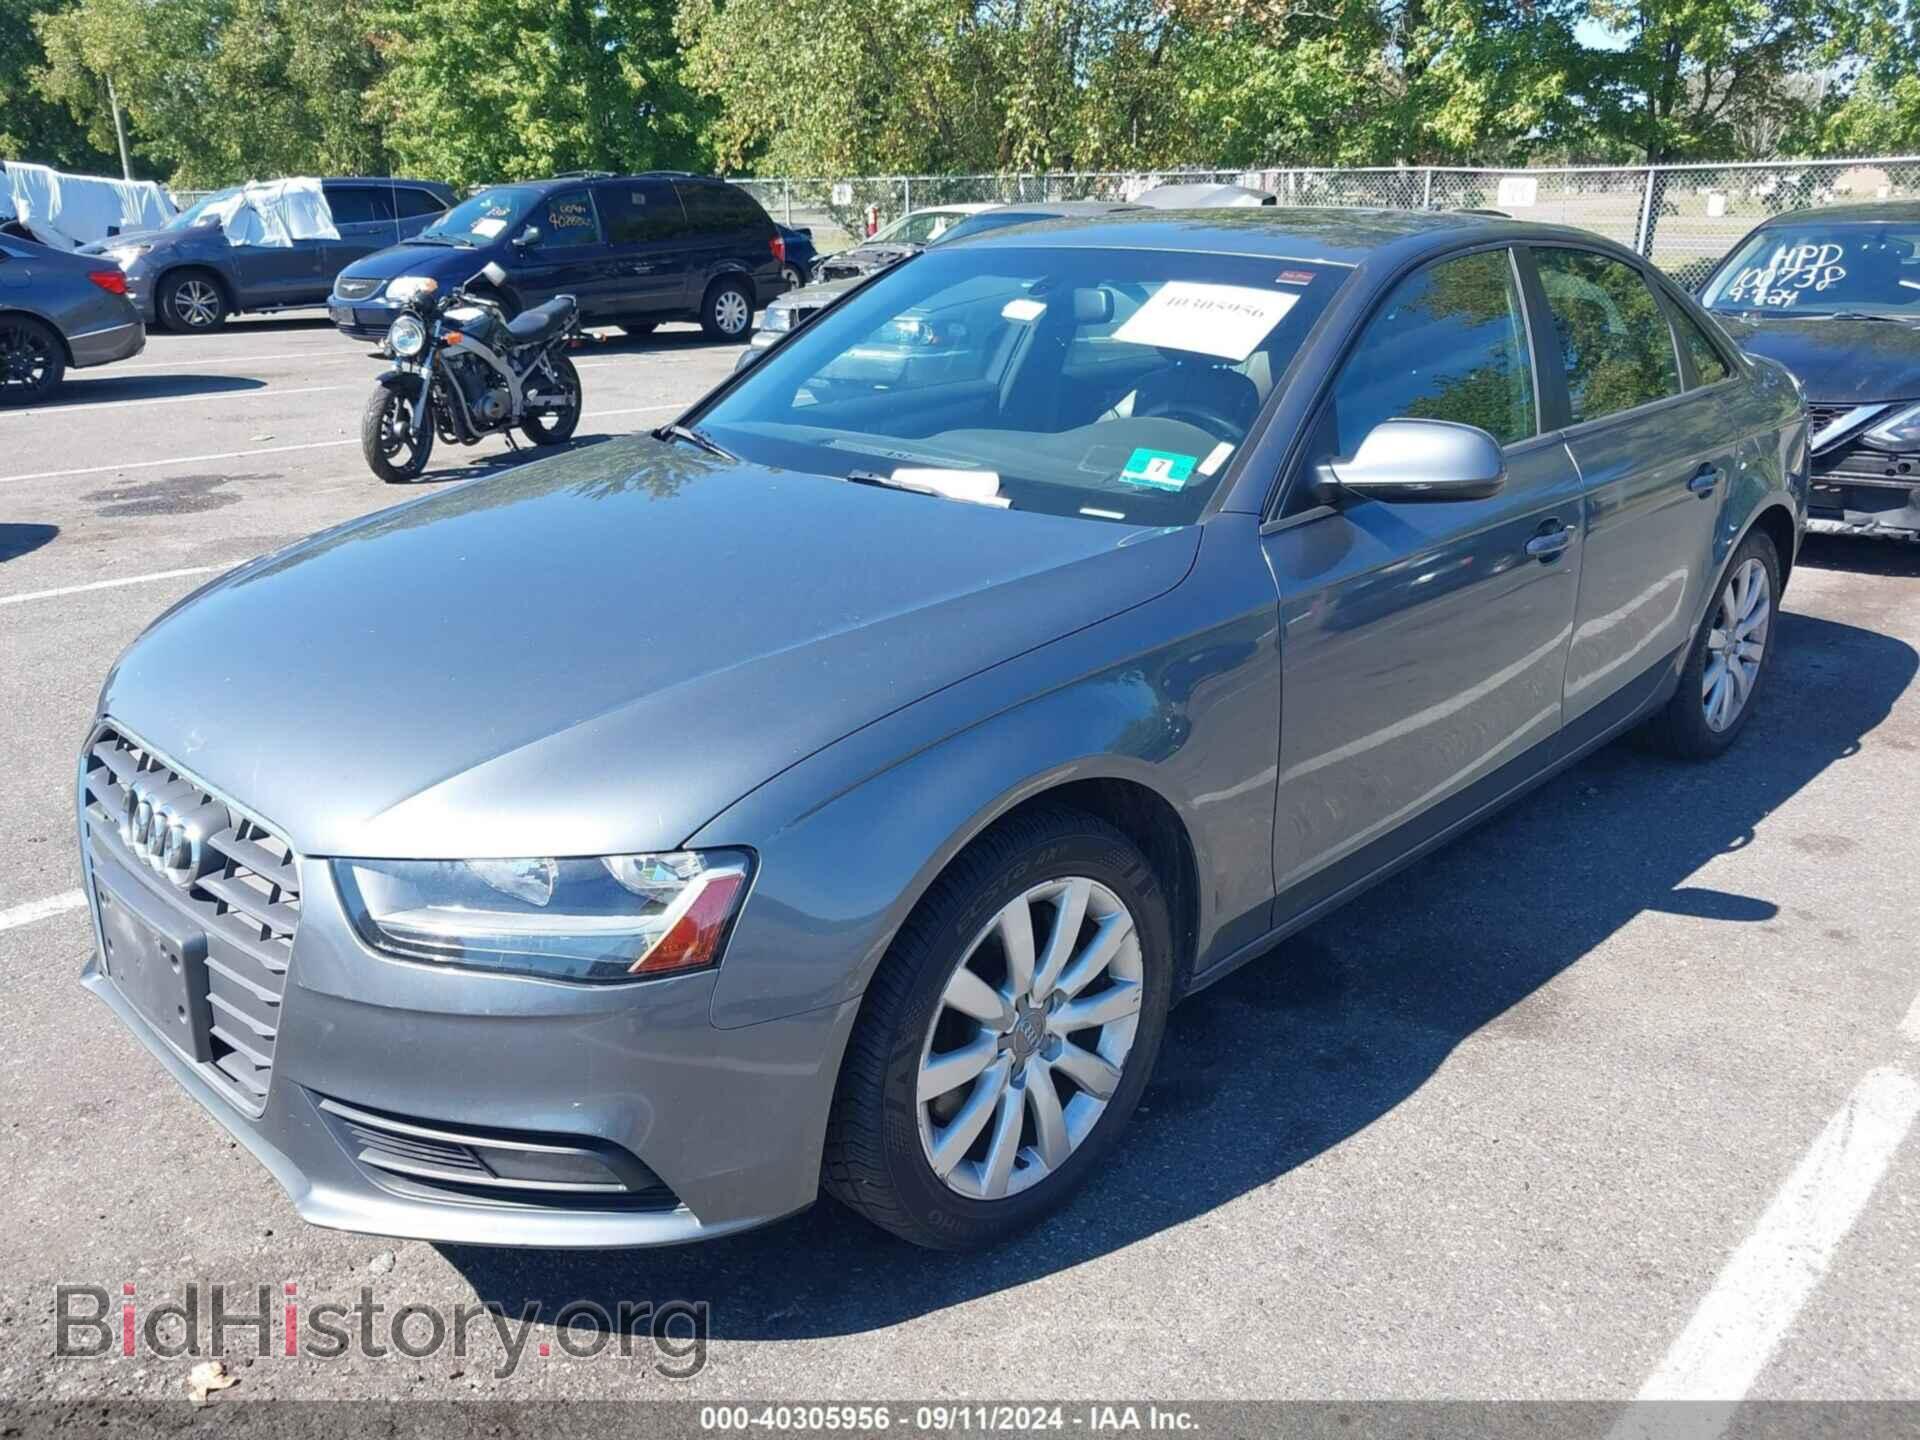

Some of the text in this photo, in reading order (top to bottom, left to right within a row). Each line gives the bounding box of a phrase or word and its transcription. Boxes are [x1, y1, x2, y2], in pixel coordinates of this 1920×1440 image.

[1769, 244, 1844, 270] HPD
[1733, 266, 1846, 291] 100738
[1154, 461, 1166, 473] 7
